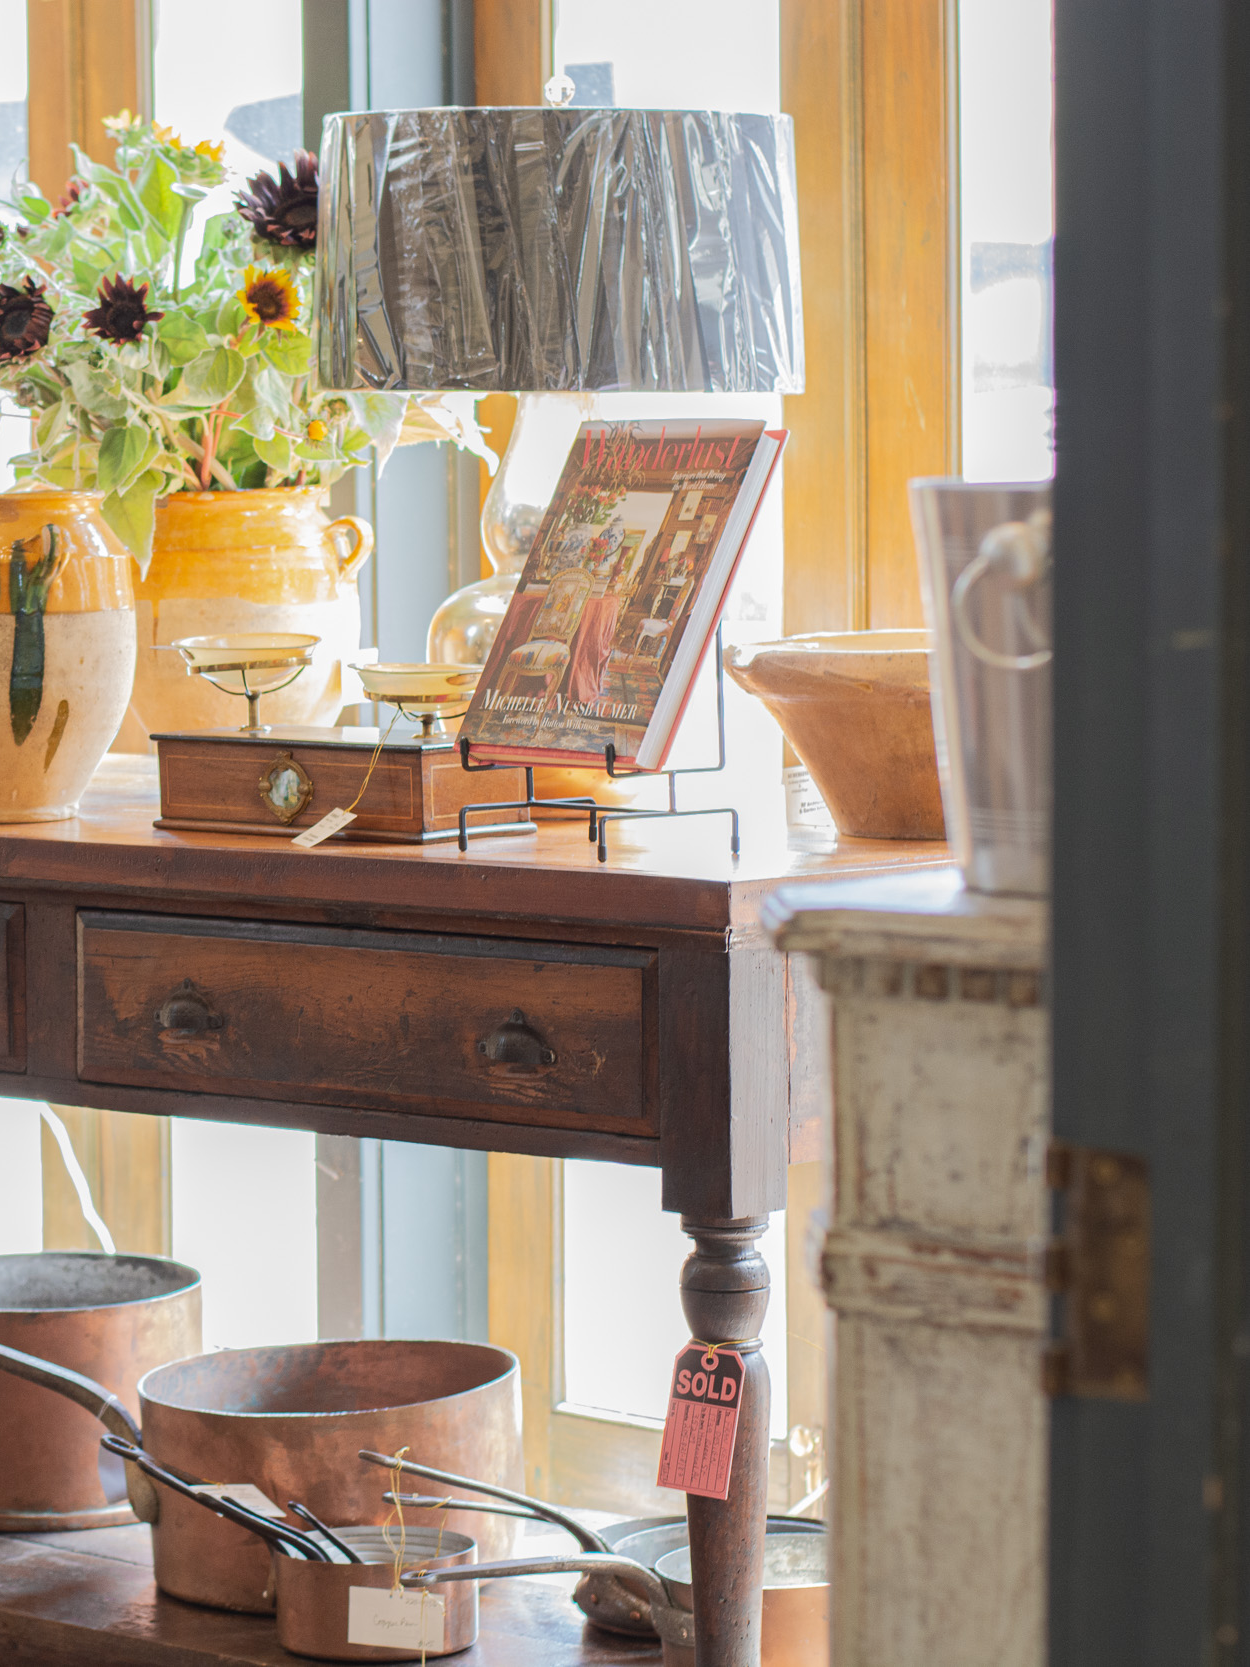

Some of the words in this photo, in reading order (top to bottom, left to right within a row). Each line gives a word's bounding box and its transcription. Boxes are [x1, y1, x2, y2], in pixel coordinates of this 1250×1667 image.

[581, 425, 742, 470] Wanderlust
[479, 688, 547, 713] MICHELLE
[554, 692, 638, 720] NUSSBAUMER
[676, 1369, 737, 1402] SOLD
